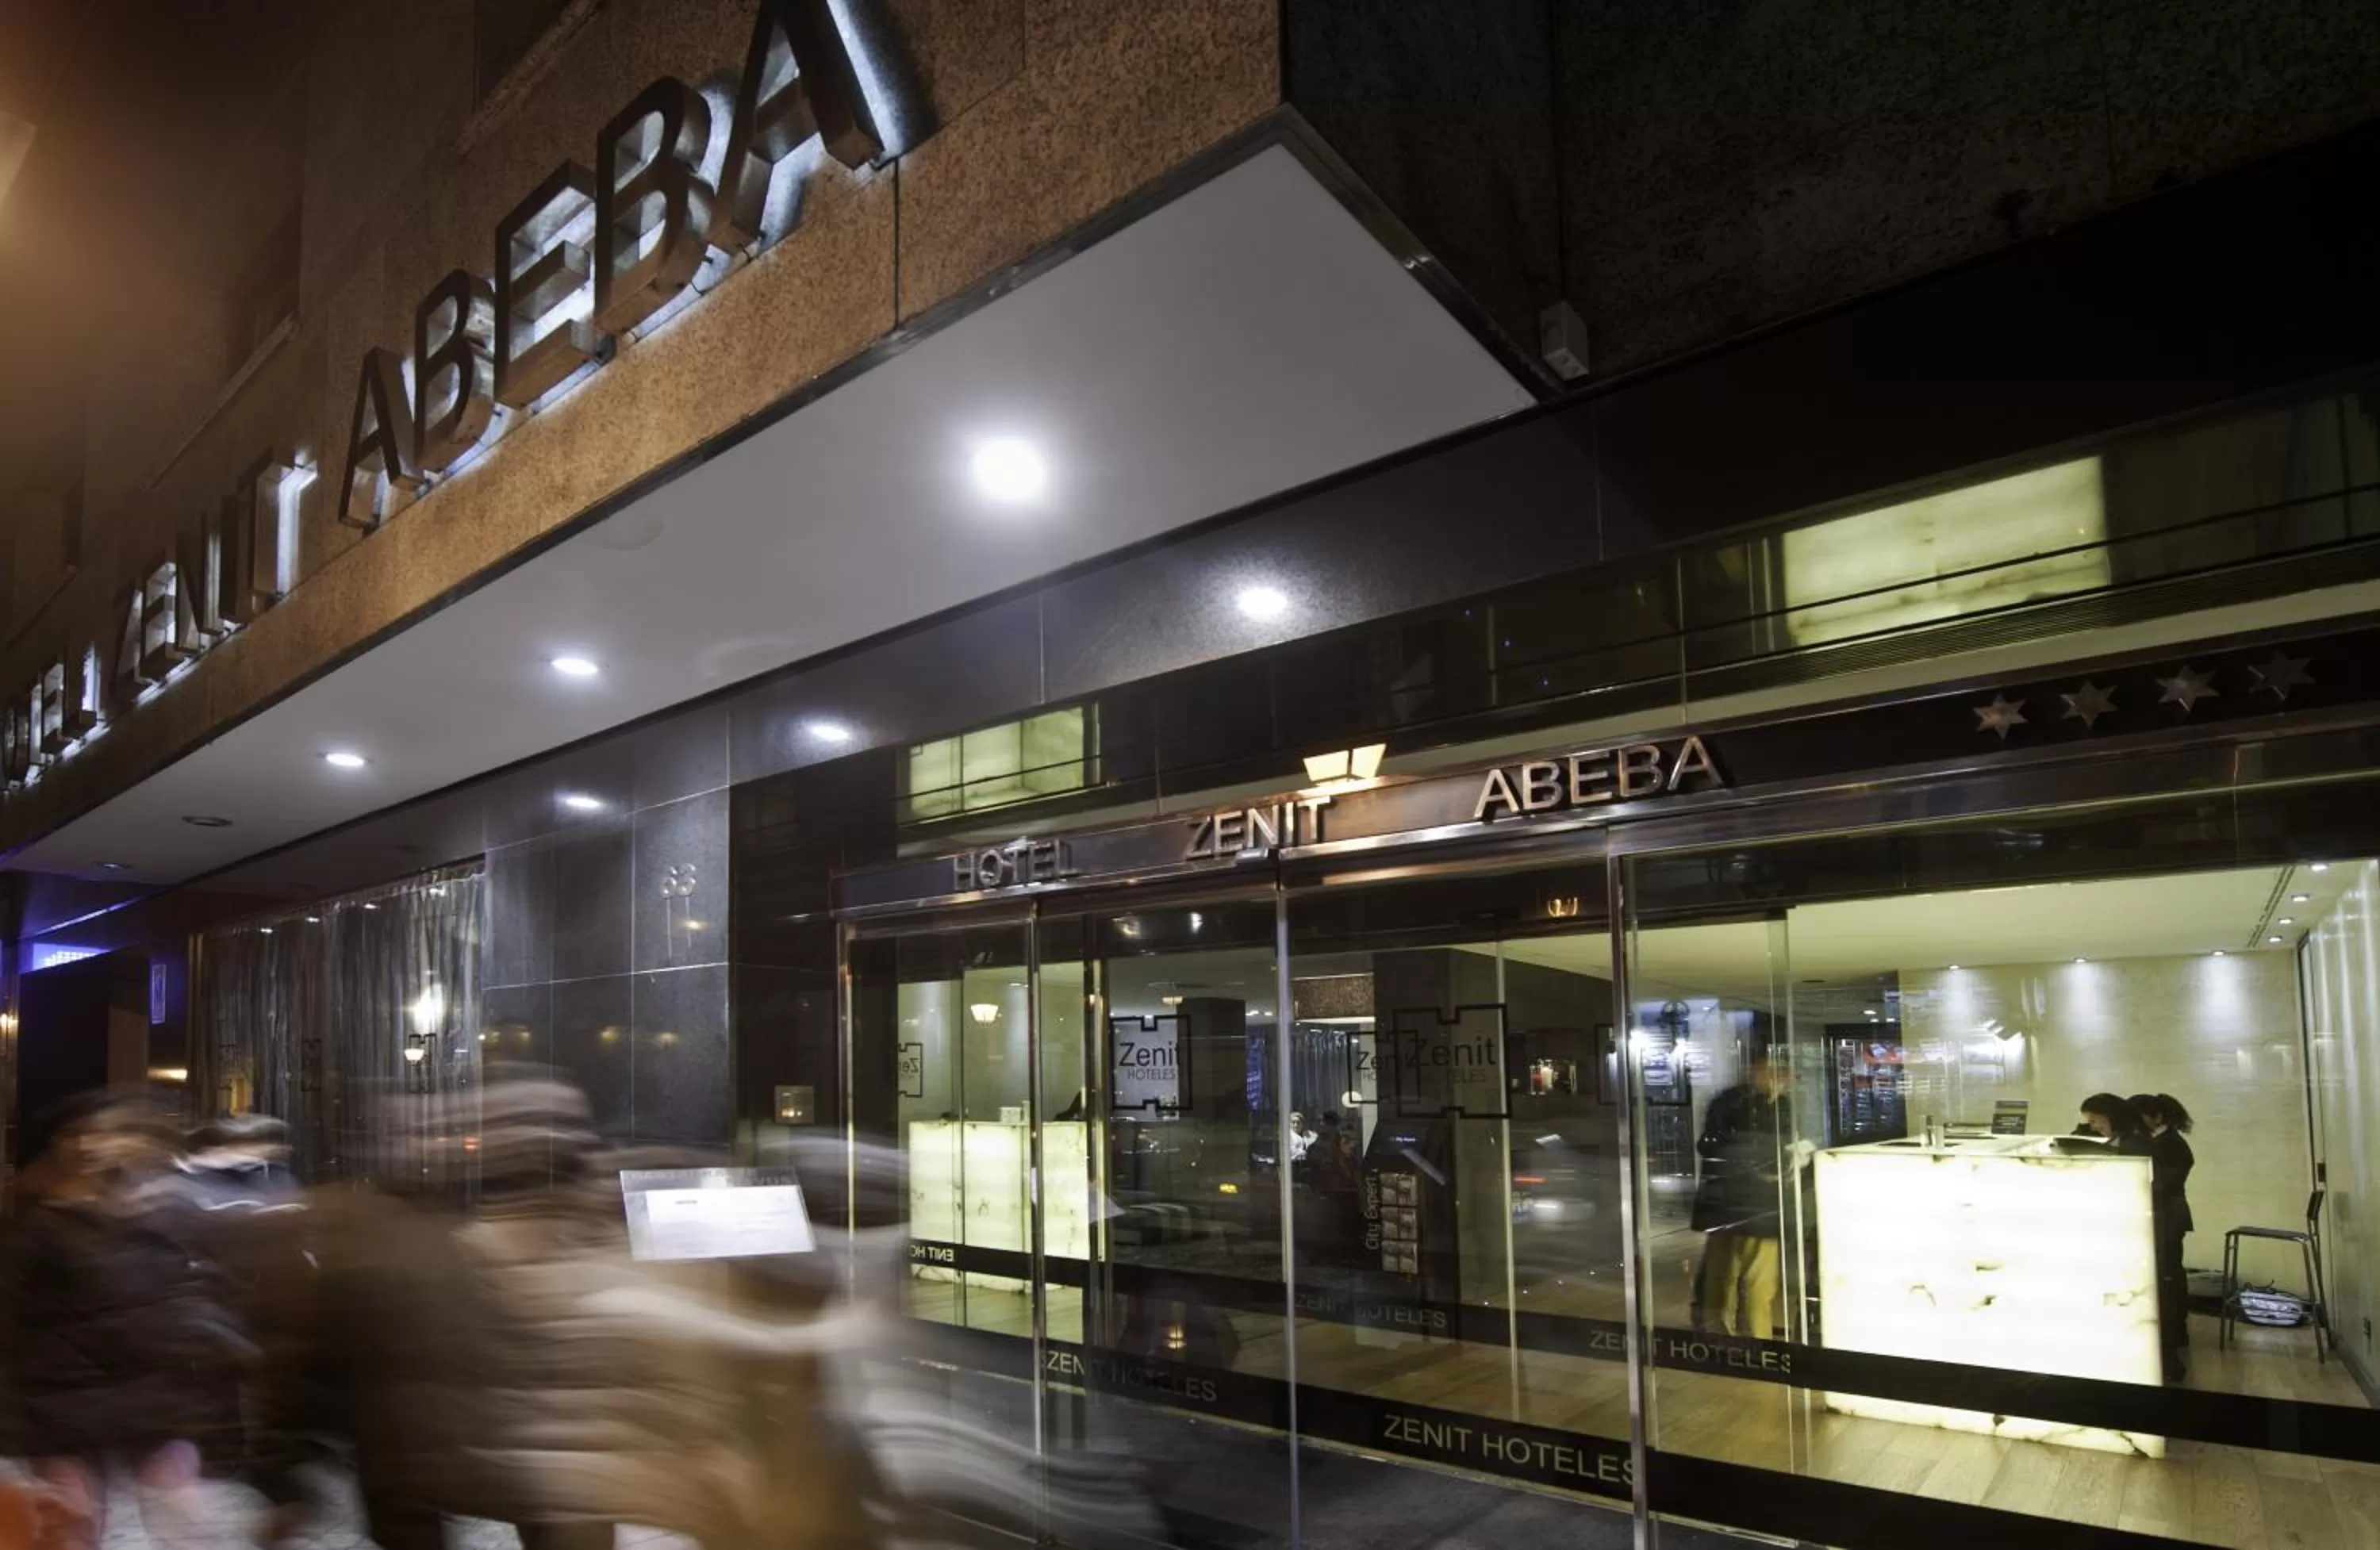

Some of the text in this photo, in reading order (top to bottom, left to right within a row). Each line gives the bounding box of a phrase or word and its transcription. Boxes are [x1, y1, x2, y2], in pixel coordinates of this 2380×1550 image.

[109, 446, 315, 706] ZENIT
[339, 0, 885, 530] ABEBA
[953, 735, 1723, 891] HOTEL ZENIT ABEBA
[1119, 1042, 1180, 1067] Zenit
[1407, 1035, 1497, 1067] Zenit
[1127, 1068, 1176, 1080] HOTELES
[1669, 1338, 1791, 1374] HOTELES
[1383, 1414, 1637, 1486] ZENIT HOTELES
